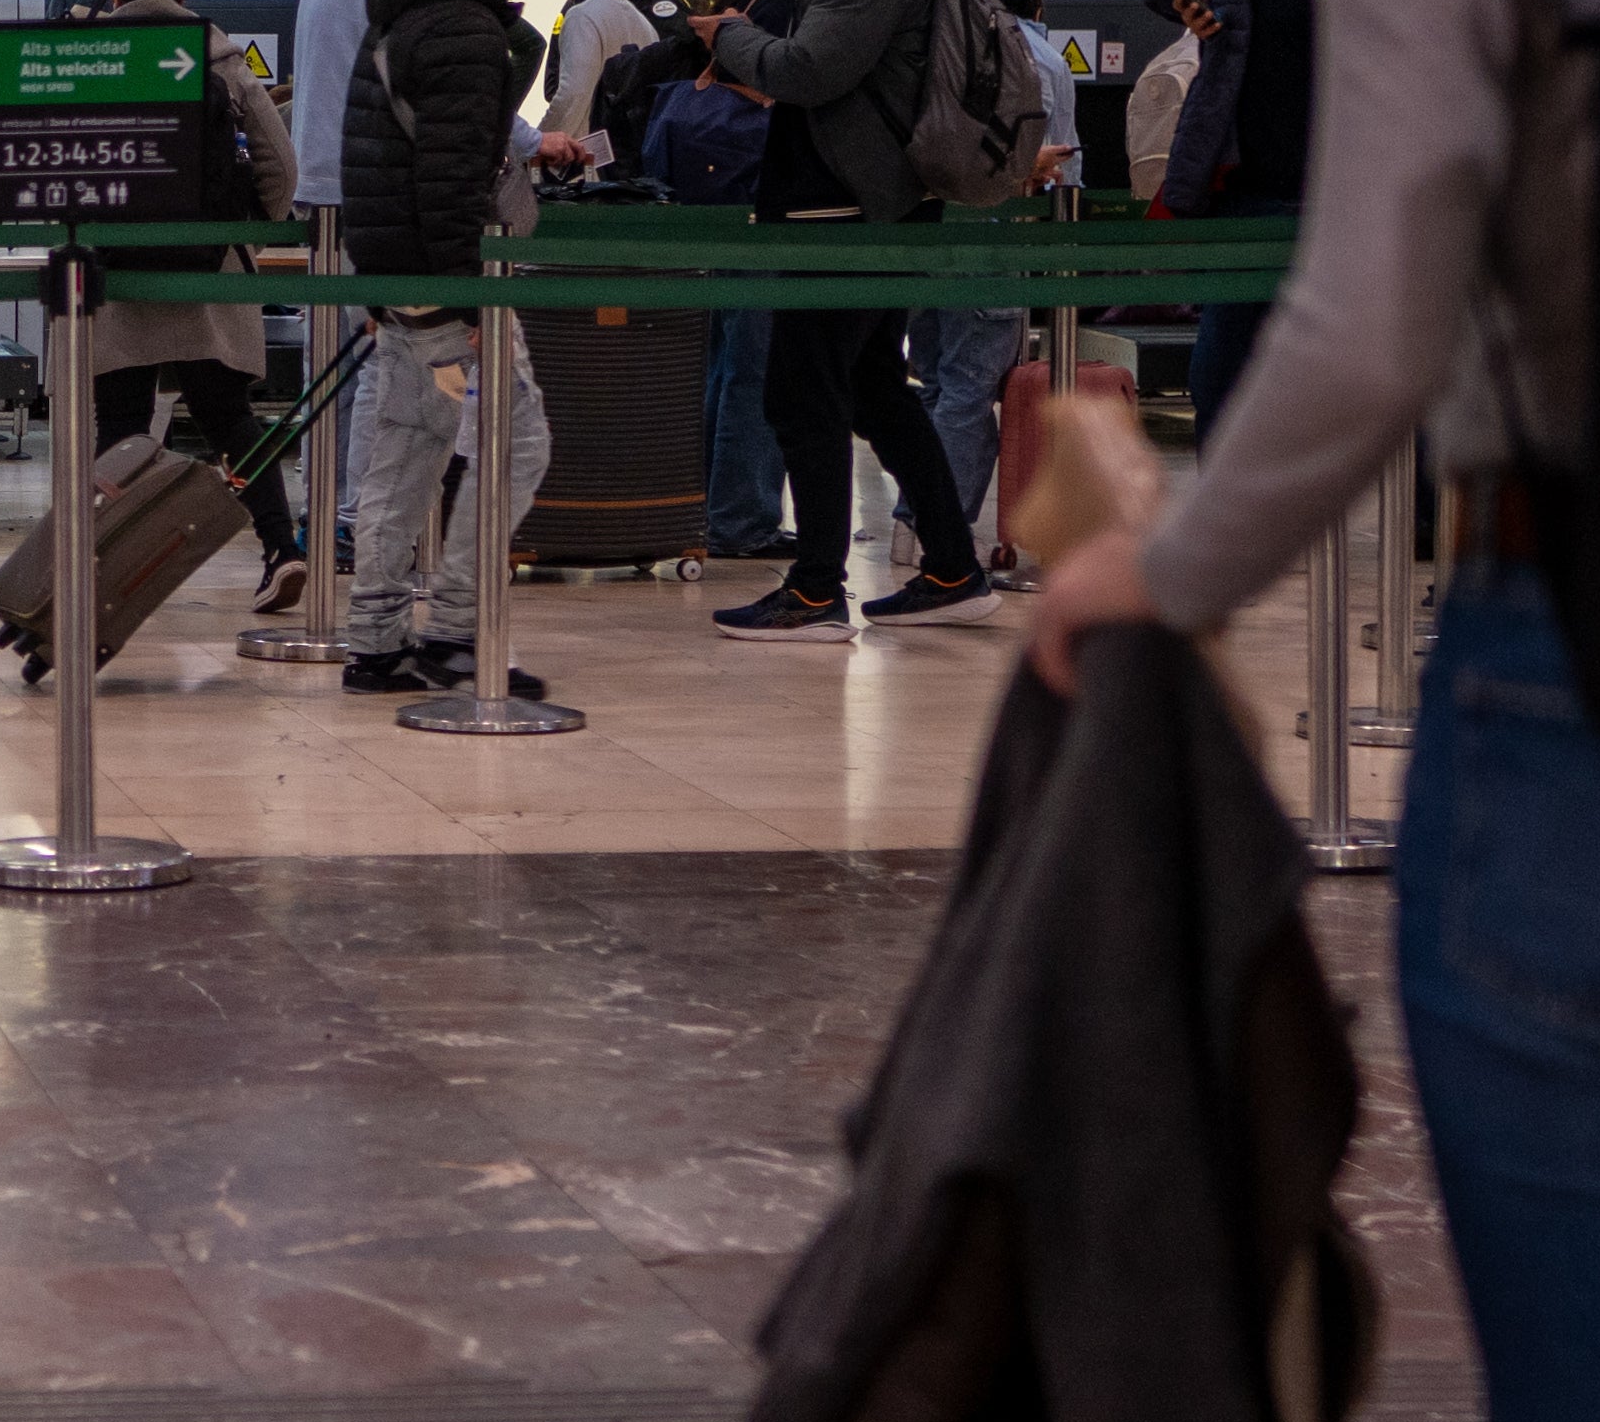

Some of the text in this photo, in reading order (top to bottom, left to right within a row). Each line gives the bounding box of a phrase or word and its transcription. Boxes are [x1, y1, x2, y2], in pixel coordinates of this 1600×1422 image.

[21, 40, 131, 56] Alta velocidad
[20, 60, 126, 77] Alta velocitat
